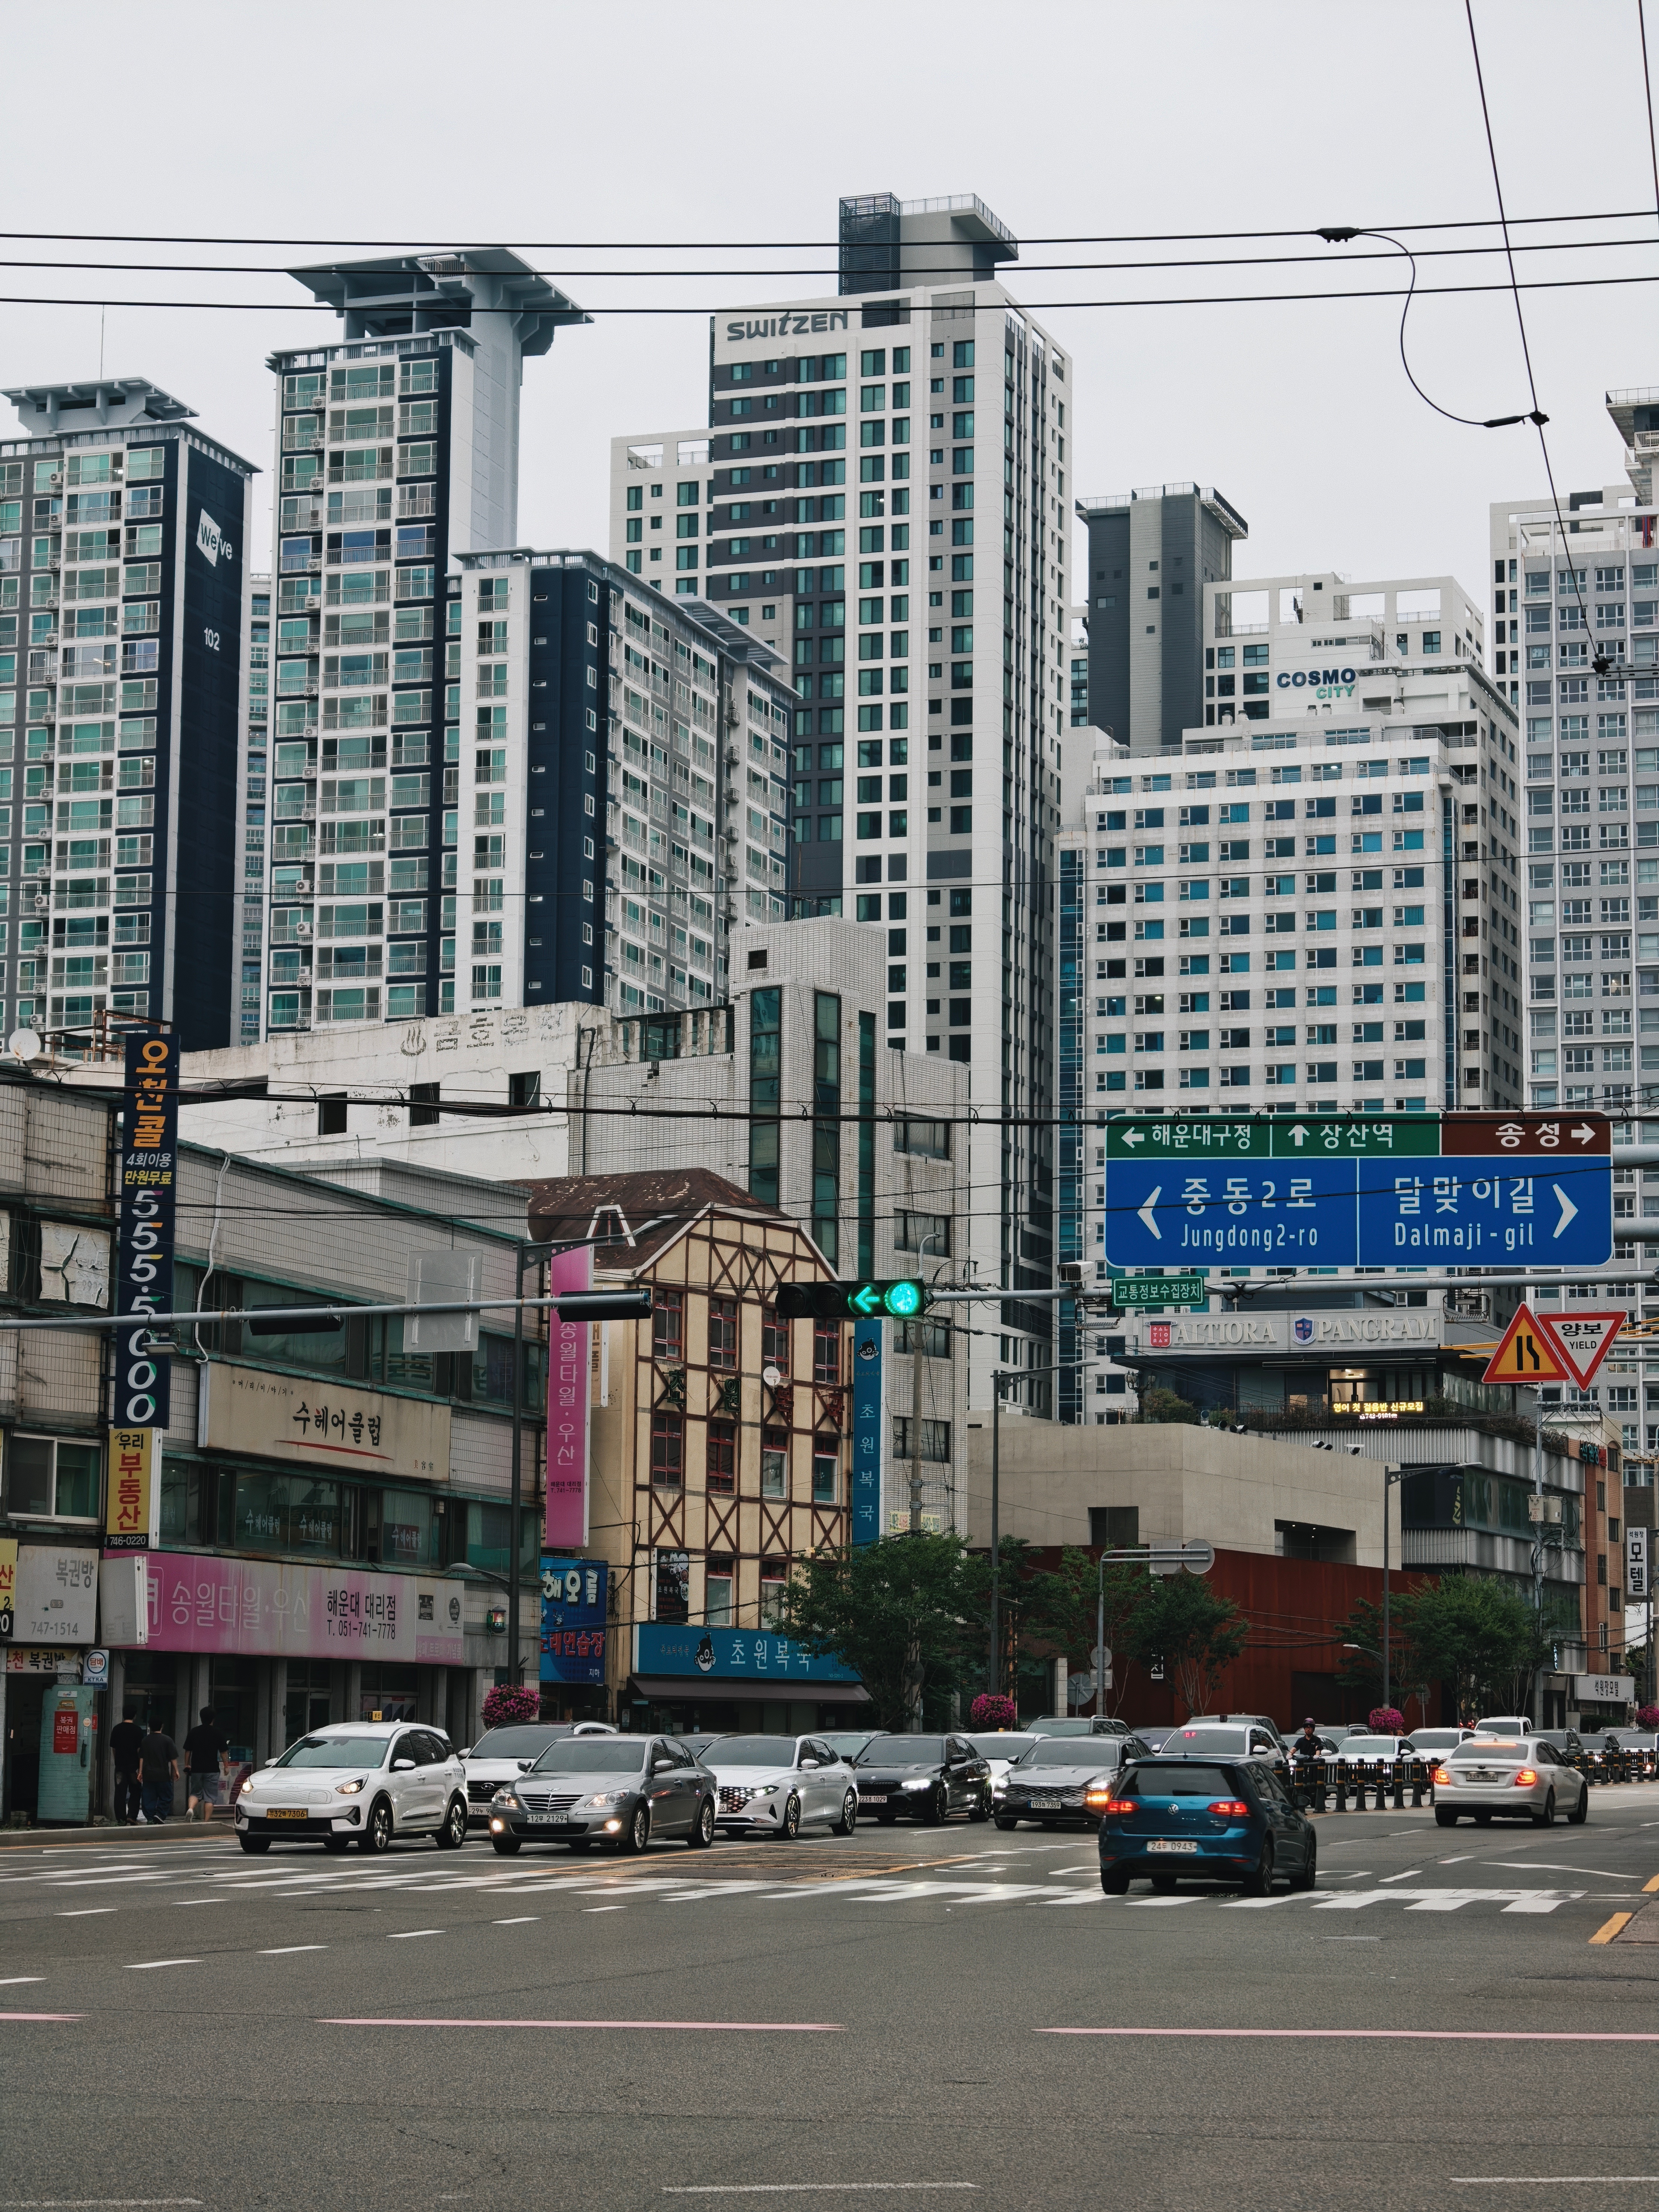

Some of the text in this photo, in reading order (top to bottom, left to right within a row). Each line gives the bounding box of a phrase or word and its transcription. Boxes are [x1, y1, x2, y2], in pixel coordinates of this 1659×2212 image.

[204, 627, 220, 651] 102
[1277, 668, 1356, 687] COSMO
[1316, 684, 1355, 699] CITY
[1320, 1124, 1392, 1148] 장산역
[126, 1153, 171, 1167] 4회이용
[125, 1170, 172, 1185] 만원무료
[1181, 1178, 1316, 1215] 중동2로
[1395, 1176, 1534, 1214] 달맞이길
[1181, 1224, 1318, 1251] Jungdong2-ro
[1118, 1283, 1199, 1300] 교통정보수집장치
[1173, 1320, 1277, 1345] ALTIORA
[1318, 1317, 1436, 1342] PANGRAM
[1561, 1323, 1603, 1336] 양보
[1570, 1341, 1597, 1349] YIELD
[1391, 1402, 1423, 1411] 신규모집
[293, 1402, 381, 1446] 수헤어클럽
[119, 1434, 144, 1450] 우리
[859, 1404, 876, 1522] 초원복국
[117, 1453, 142, 1531] 부동산
[110, 1536, 146, 1546] 746-0220
[56, 1557, 94, 1588] 복권방
[1630, 1543, 1644, 1592] 모텔
[541, 1567, 599, 1605] 해오름
[327, 1589, 396, 1621] 해운대 대리점
[32, 1621, 78, 1636] 747-1514
[338, 1620, 396, 1639] 051-741-7778
[90, 1658, 103, 1666] 담배
[730, 1639, 811, 1672] 초원복국
[589, 1668, 600, 1677] 지하
[1595, 1680, 1619, 1697] 석원장모텔
[56, 1725, 76, 1735] 판매점
